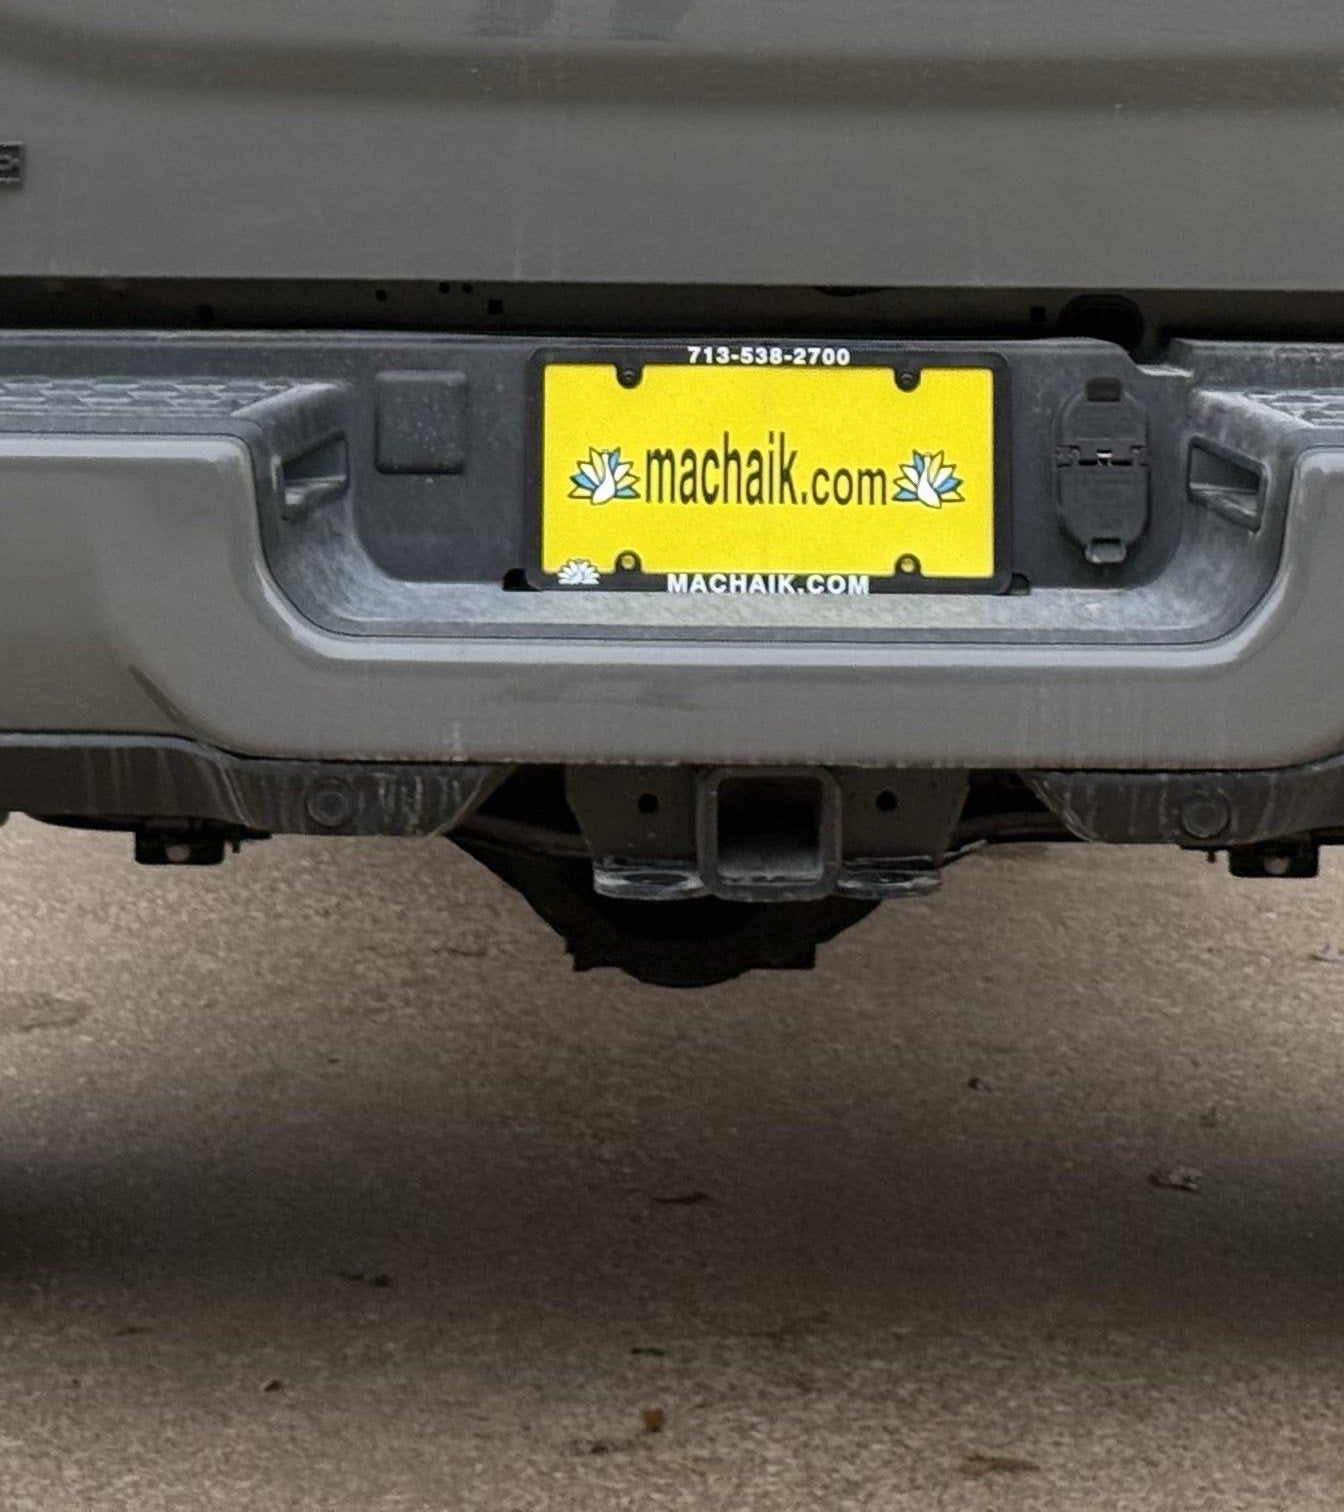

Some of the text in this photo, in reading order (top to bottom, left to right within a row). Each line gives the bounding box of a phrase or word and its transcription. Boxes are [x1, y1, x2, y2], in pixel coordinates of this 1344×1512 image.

[687, 346, 852, 366] 713-538-2700
[645, 431, 888, 506] machaik.com
[666, 573, 869, 596] MACHAIK.COM
